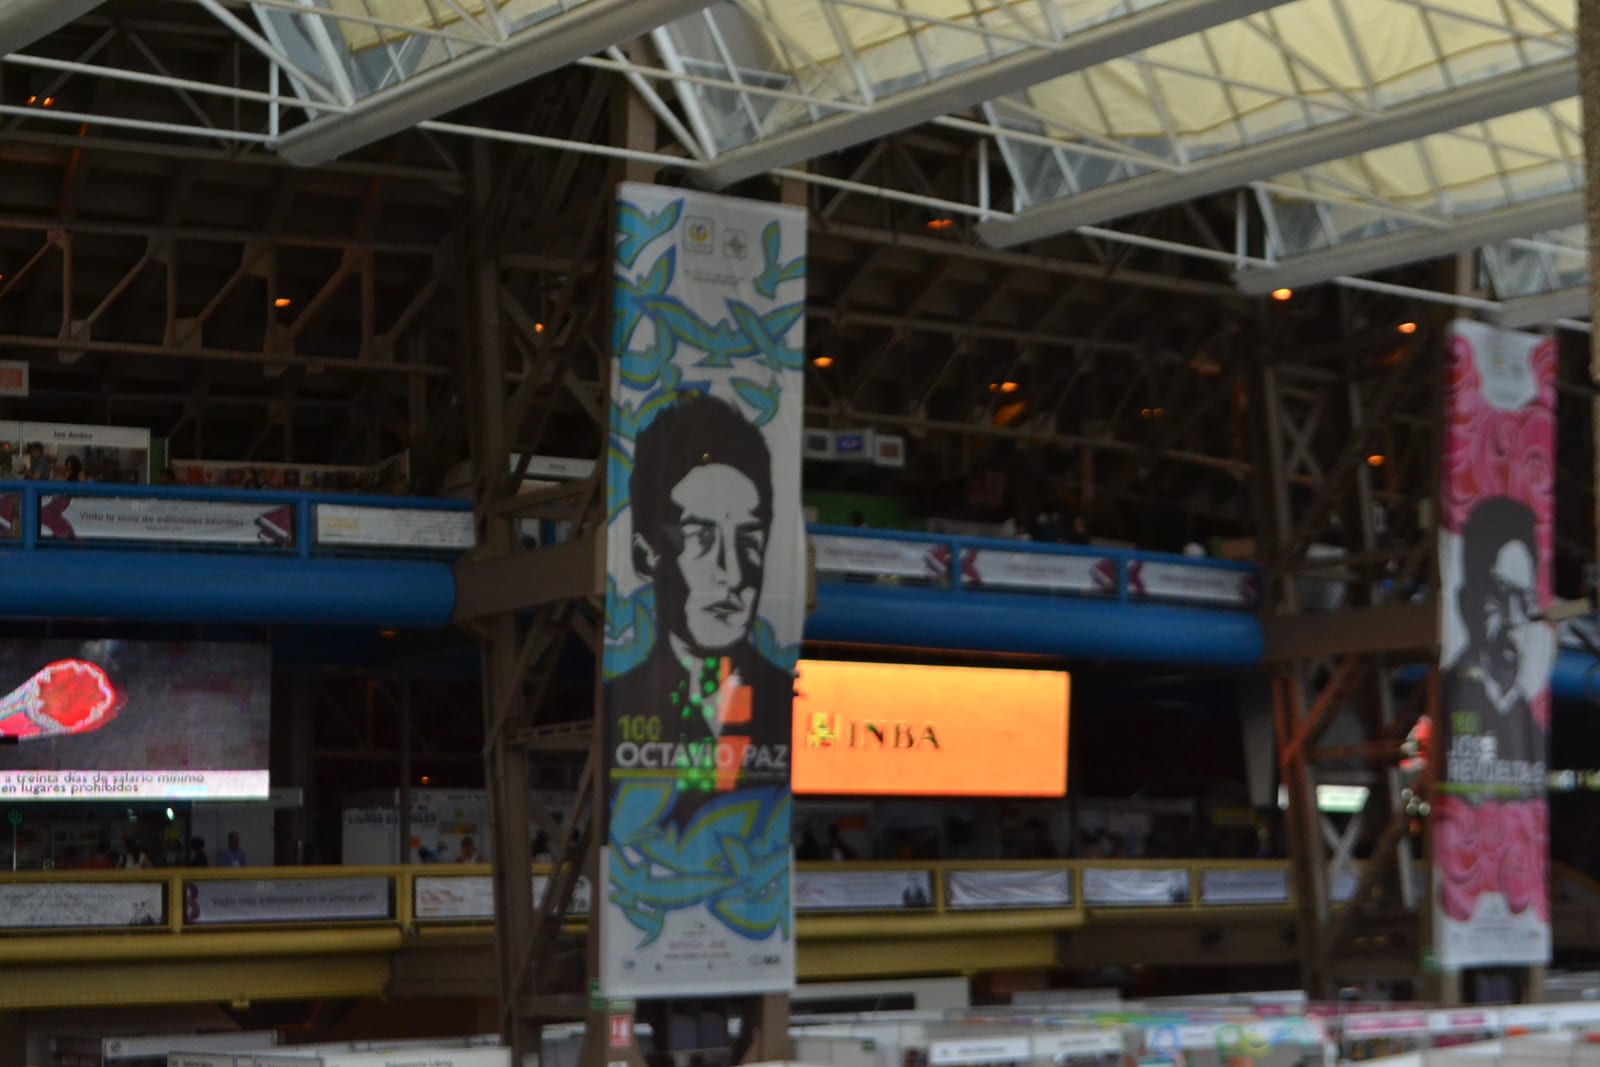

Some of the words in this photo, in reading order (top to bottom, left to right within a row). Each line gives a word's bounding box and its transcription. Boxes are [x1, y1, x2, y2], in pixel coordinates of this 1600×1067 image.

[849, 720, 942, 749] INBA
[614, 740, 735, 768] OCTAVIO
[742, 743, 789, 768] PAZ
[1, 784, 17, 793] en
[21, 781, 66, 795] lugares
[70, 780, 139, 795] prohibidos
[16, 773, 59, 783] treinta
[92, 771, 108, 783] de
[112, 771, 154, 783] salario
